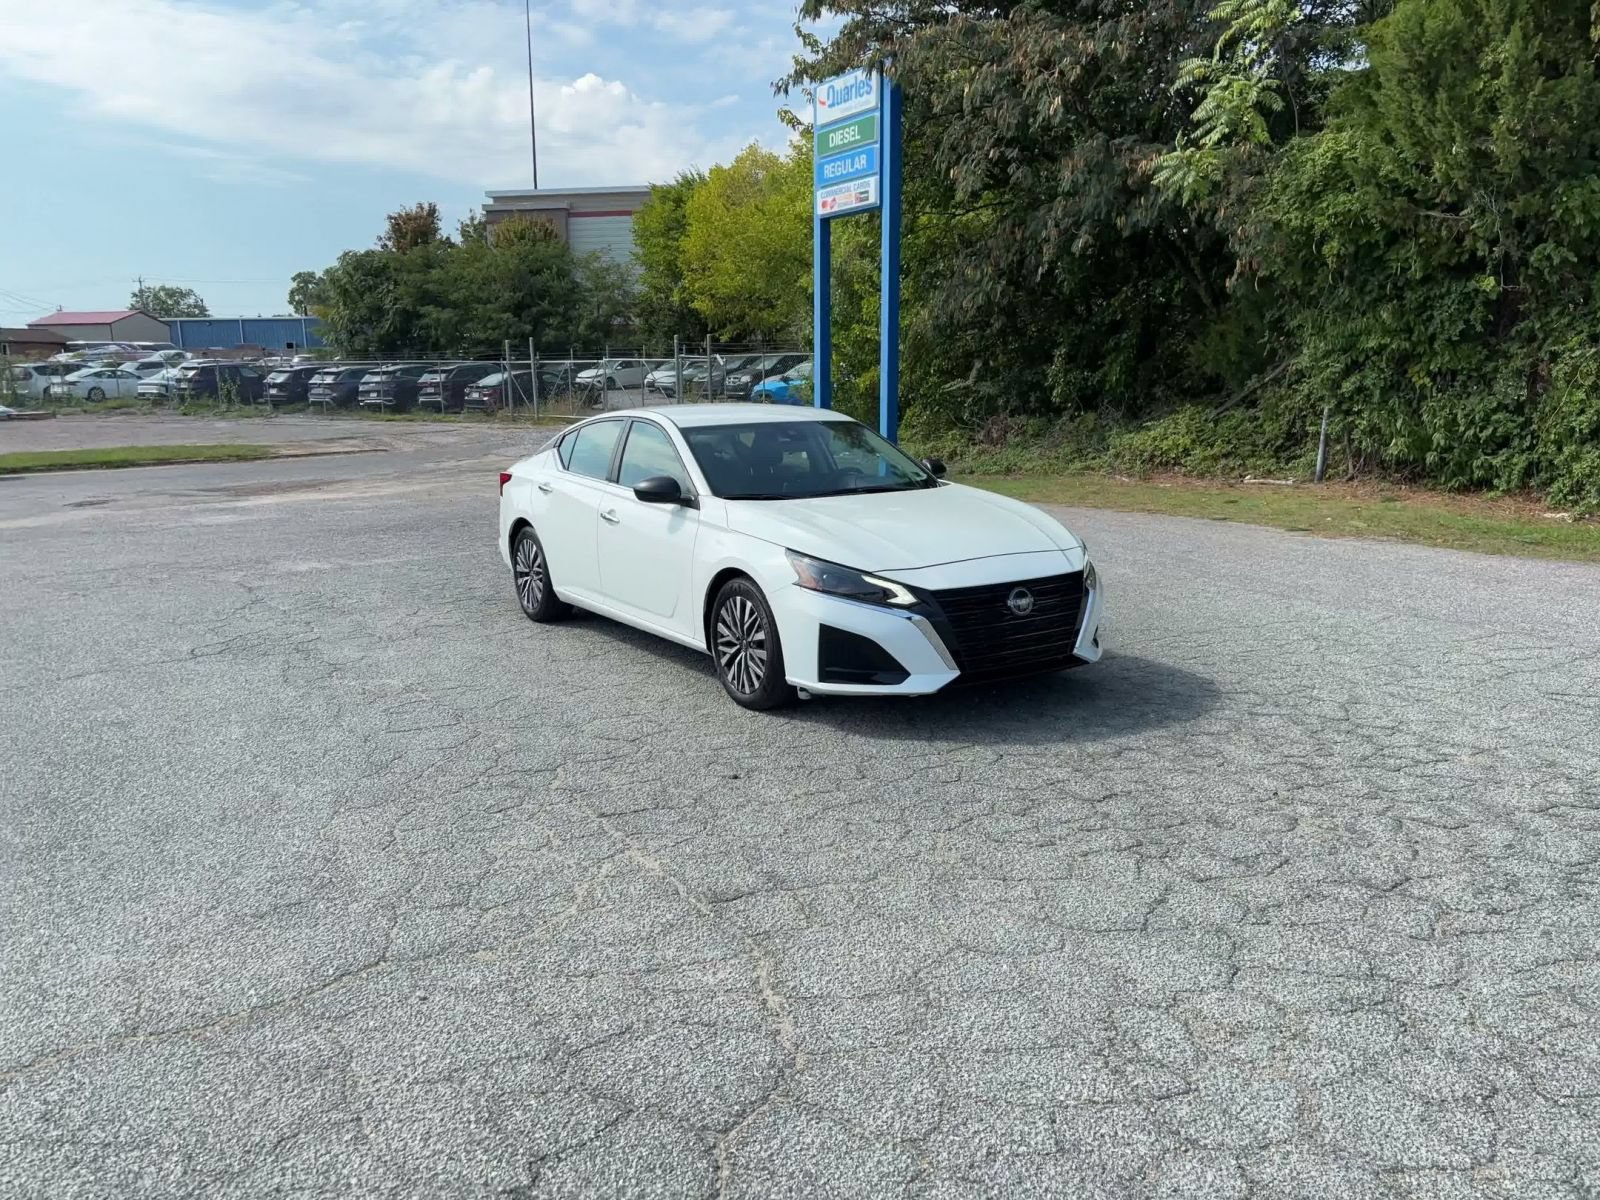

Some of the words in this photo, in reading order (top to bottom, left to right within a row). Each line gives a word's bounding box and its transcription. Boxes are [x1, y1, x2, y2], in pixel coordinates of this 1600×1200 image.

[827, 76, 872, 108] Quarles
[829, 125, 860, 147] DIESEL
[824, 154, 867, 178] REGULAR
